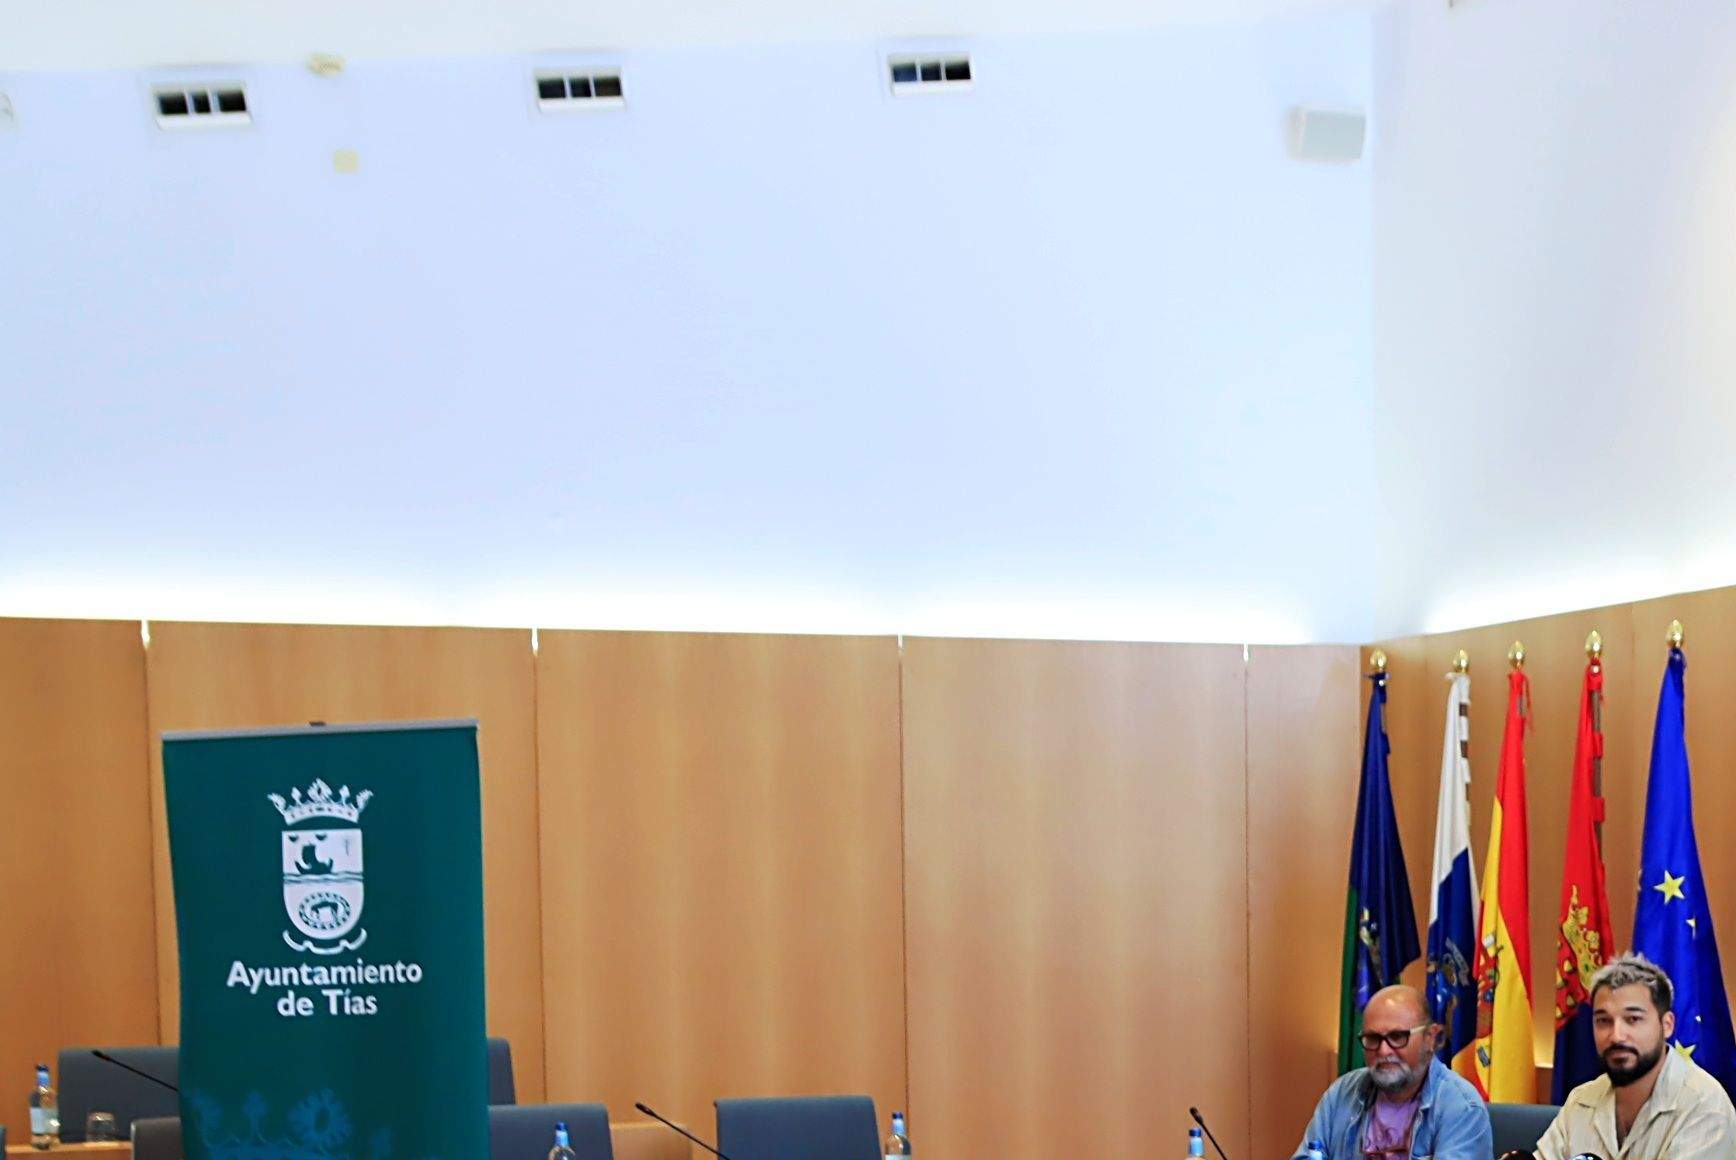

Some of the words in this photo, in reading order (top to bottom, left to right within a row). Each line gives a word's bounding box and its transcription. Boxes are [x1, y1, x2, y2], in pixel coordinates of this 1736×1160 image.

[226, 957, 423, 994] Ayuntamiento
[276, 990, 314, 1017] de
[320, 987, 379, 1016] Tías
